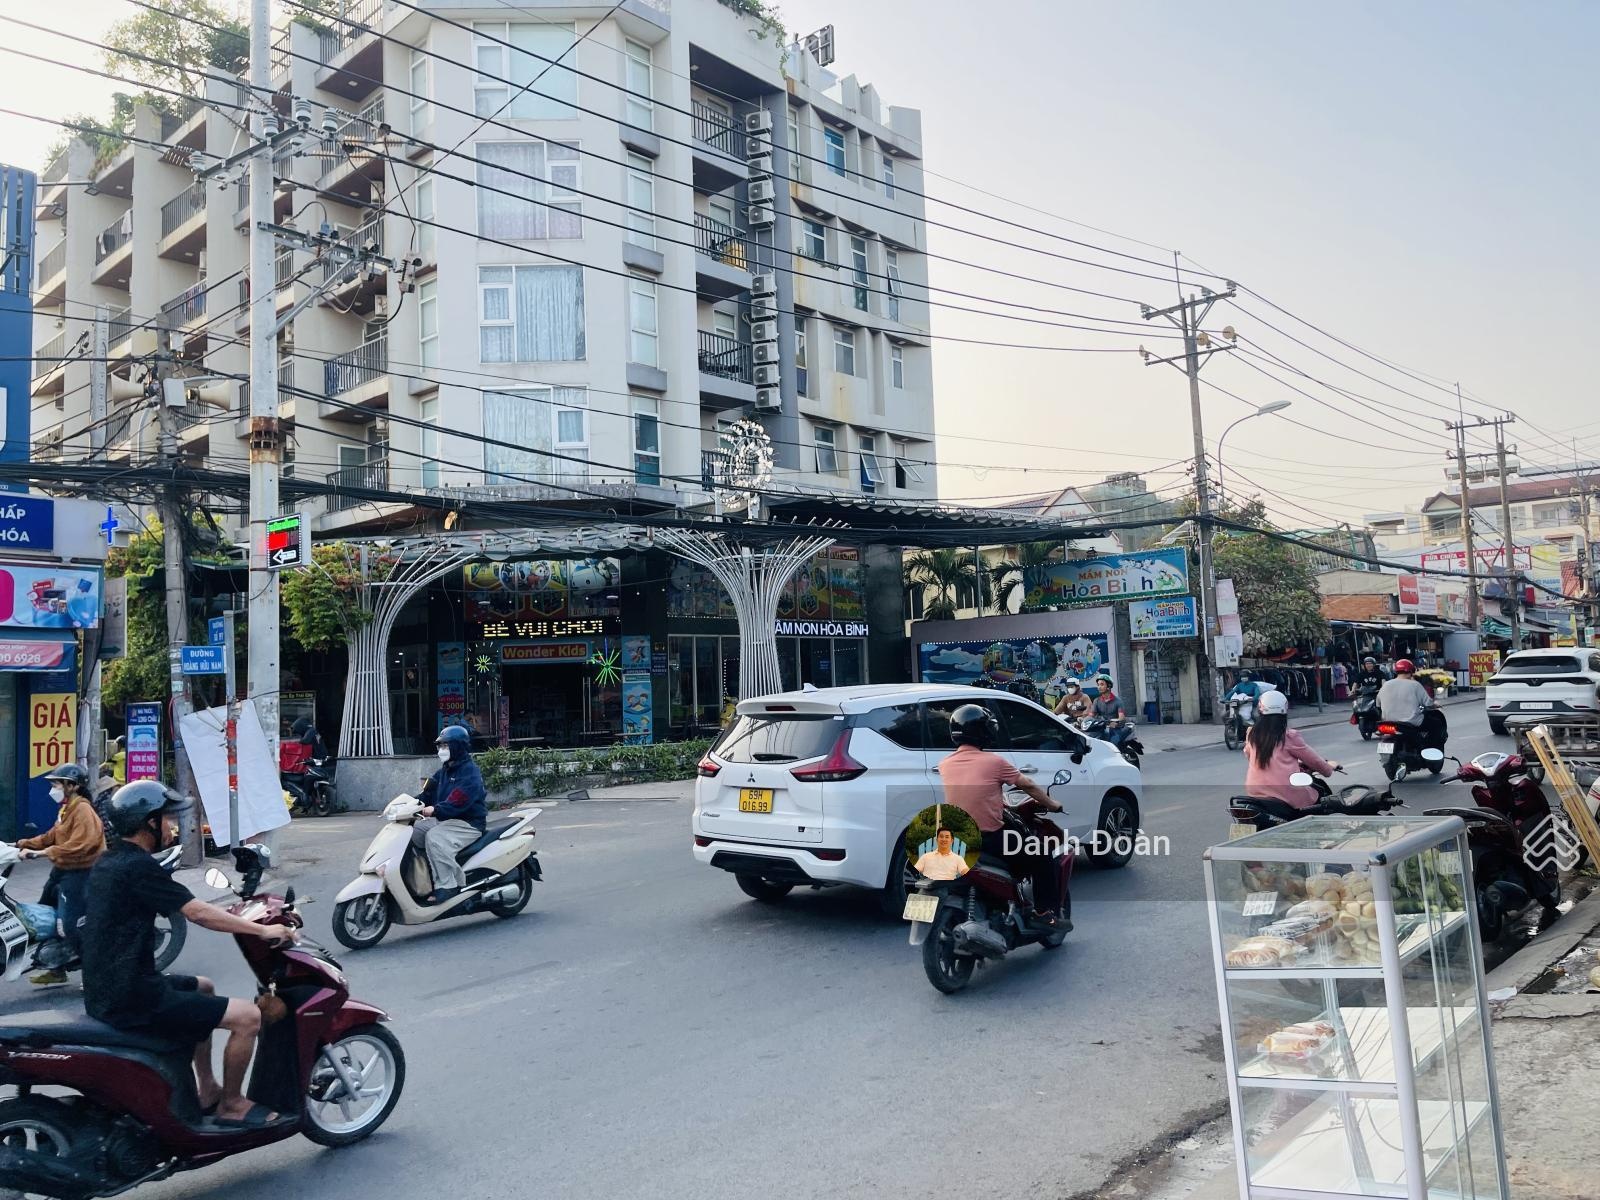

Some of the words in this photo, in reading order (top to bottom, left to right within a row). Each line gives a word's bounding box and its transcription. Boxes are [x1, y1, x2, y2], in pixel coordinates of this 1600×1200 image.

[1061, 580, 1103, 600] Hòa
[794, 621, 819, 635] NON
[820, 621, 844, 636] HÒA
[845, 621, 868, 636] BÌNH
[14, 653, 41, 663] 6928
[503, 647, 554, 658] Wonder
[558, 644, 586, 657] Kids
[33, 696, 72, 728] GIÁ
[32, 730, 74, 768] TỐT
[742, 800, 768, 812] 016.99
